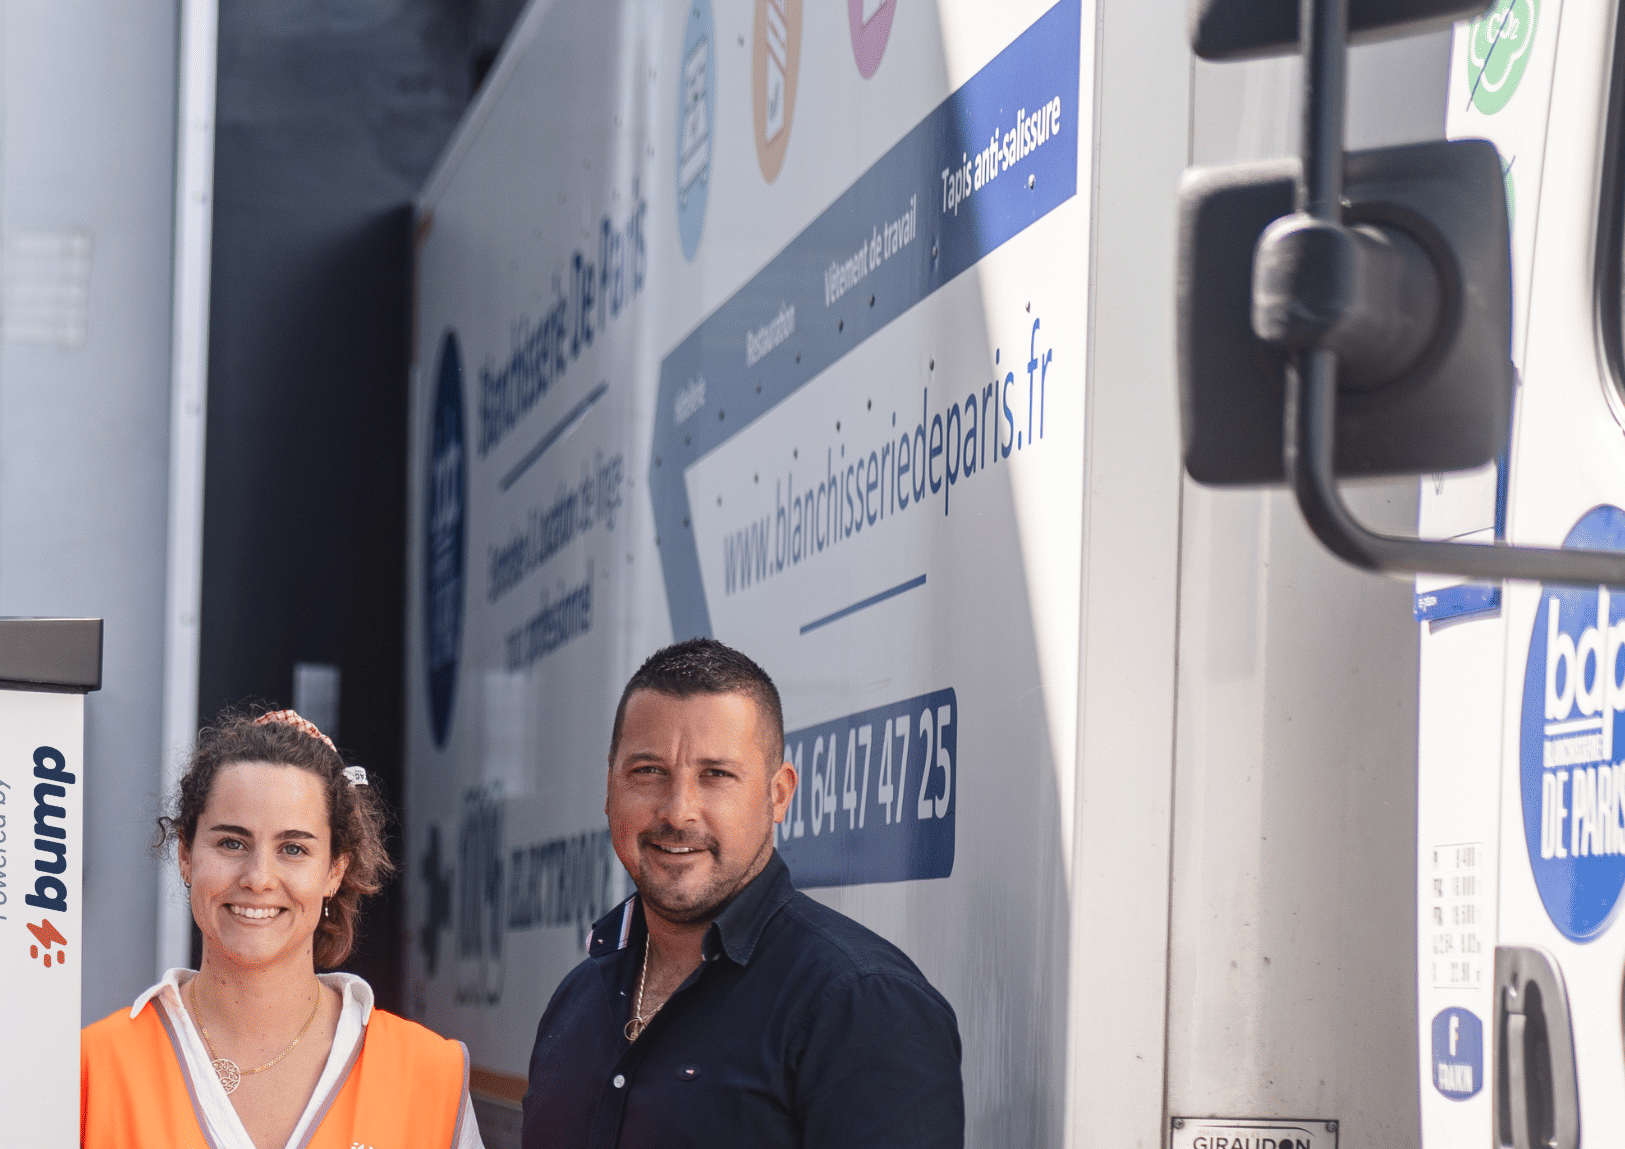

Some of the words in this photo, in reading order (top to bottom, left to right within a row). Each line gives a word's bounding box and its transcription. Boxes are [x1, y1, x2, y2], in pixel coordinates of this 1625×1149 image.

[941, 152, 972, 216] Tapis
[974, 96, 1061, 191] anti-salissure
[824, 238, 869, 308] Vêtement
[869, 224, 883, 271] de
[884, 193, 917, 260] travail
[724, 317, 1053, 598] www.blanchisseriedeparis.fr
[25, 745, 76, 912] bump
[811, 732, 837, 837] 64
[843, 723, 873, 831] 47
[878, 714, 911, 825] 47
[917, 704, 952, 820] 25
[1541, 769, 1570, 860] DE
